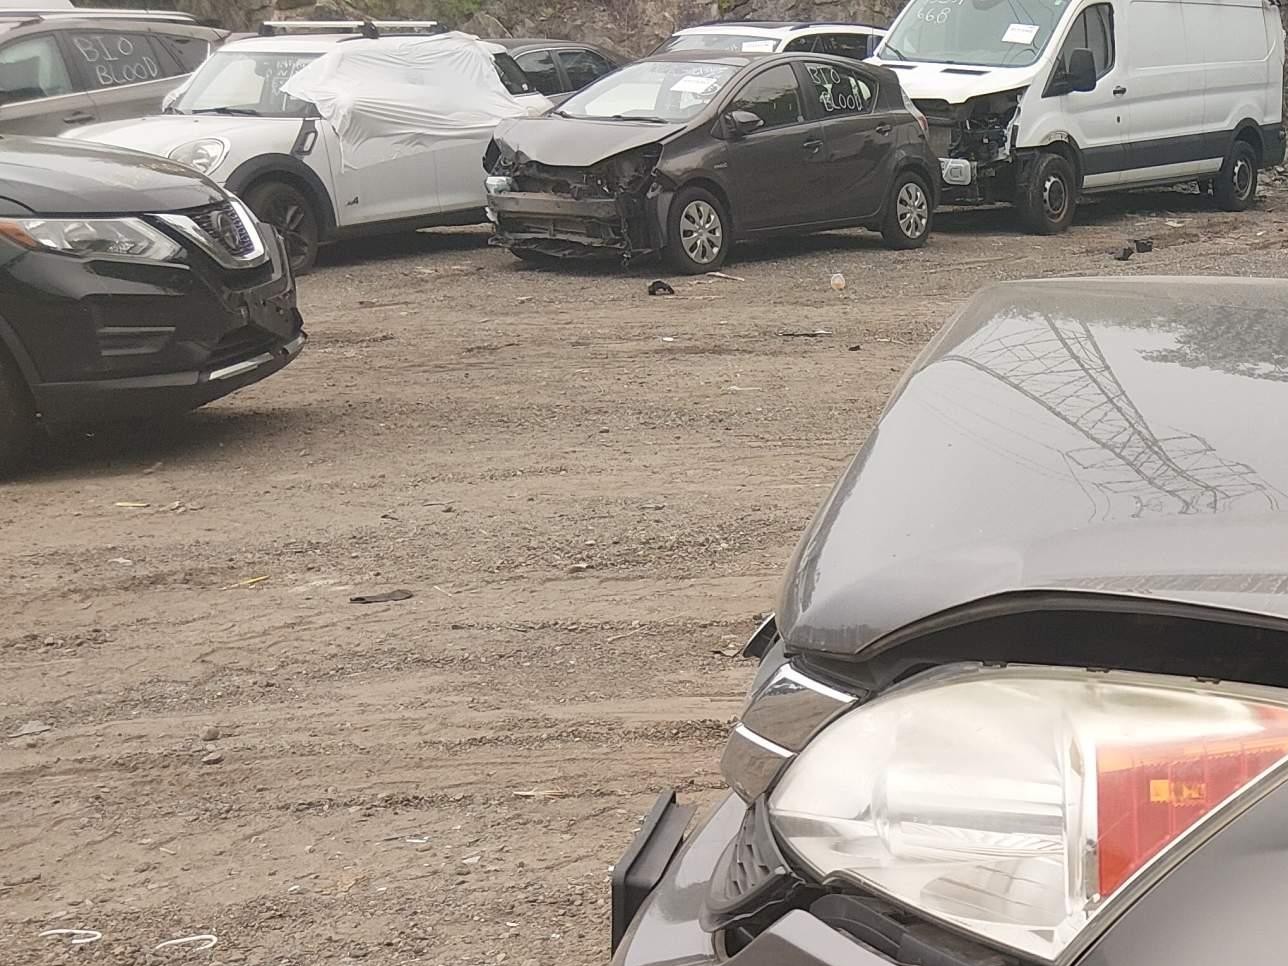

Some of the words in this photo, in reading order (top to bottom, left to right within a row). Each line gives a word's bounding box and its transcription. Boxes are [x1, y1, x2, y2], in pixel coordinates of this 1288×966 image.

[73, 35, 134, 62] BIO
[95, 56, 158, 85] BLOOD
[807, 65, 841, 84] BIO
[820, 91, 863, 112] BLOOD
